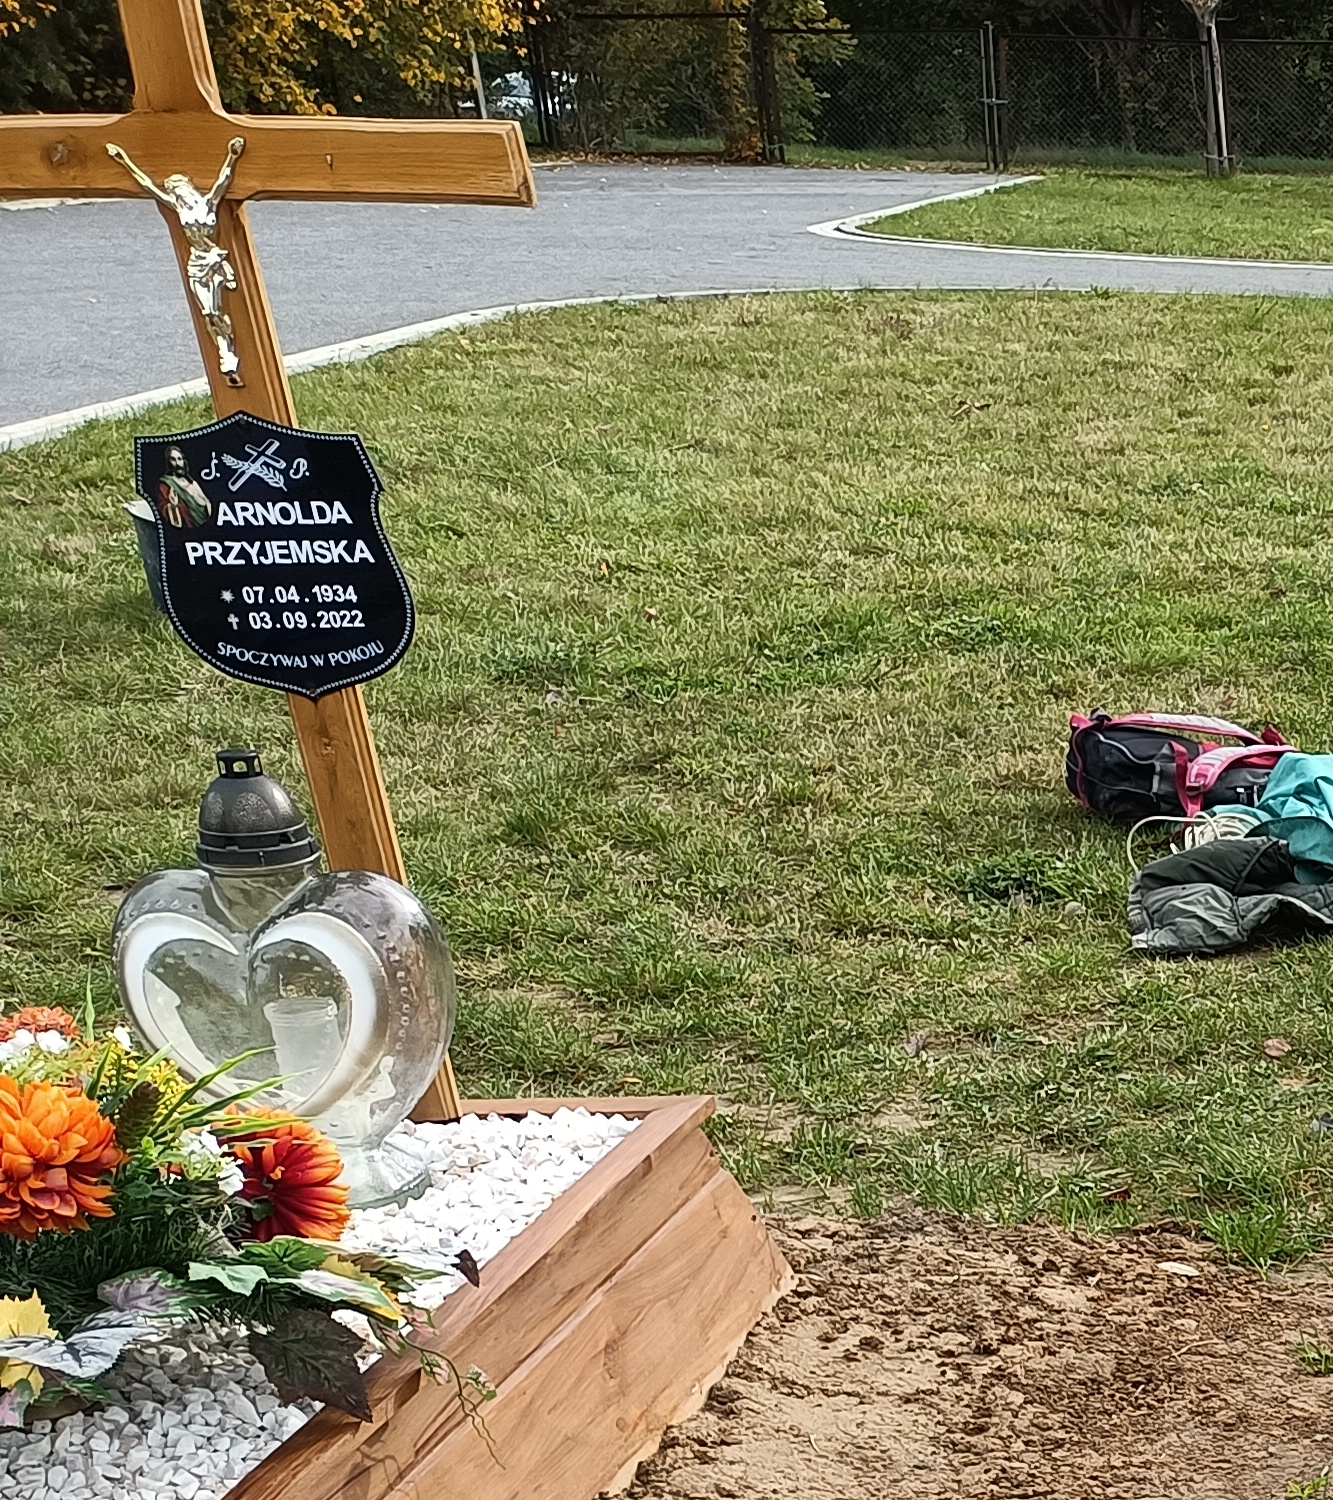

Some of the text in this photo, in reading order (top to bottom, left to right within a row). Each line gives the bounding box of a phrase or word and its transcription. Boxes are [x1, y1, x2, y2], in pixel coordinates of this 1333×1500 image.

[216, 500, 353, 527] ARNOLDA
[184, 539, 376, 566] PRZYJEMSKA
[241, 584, 359, 605] 07.04.1934
[248, 609, 367, 630] 03.09.2022
[216, 639, 386, 669] SPOCZYWAJ W POKOJU
